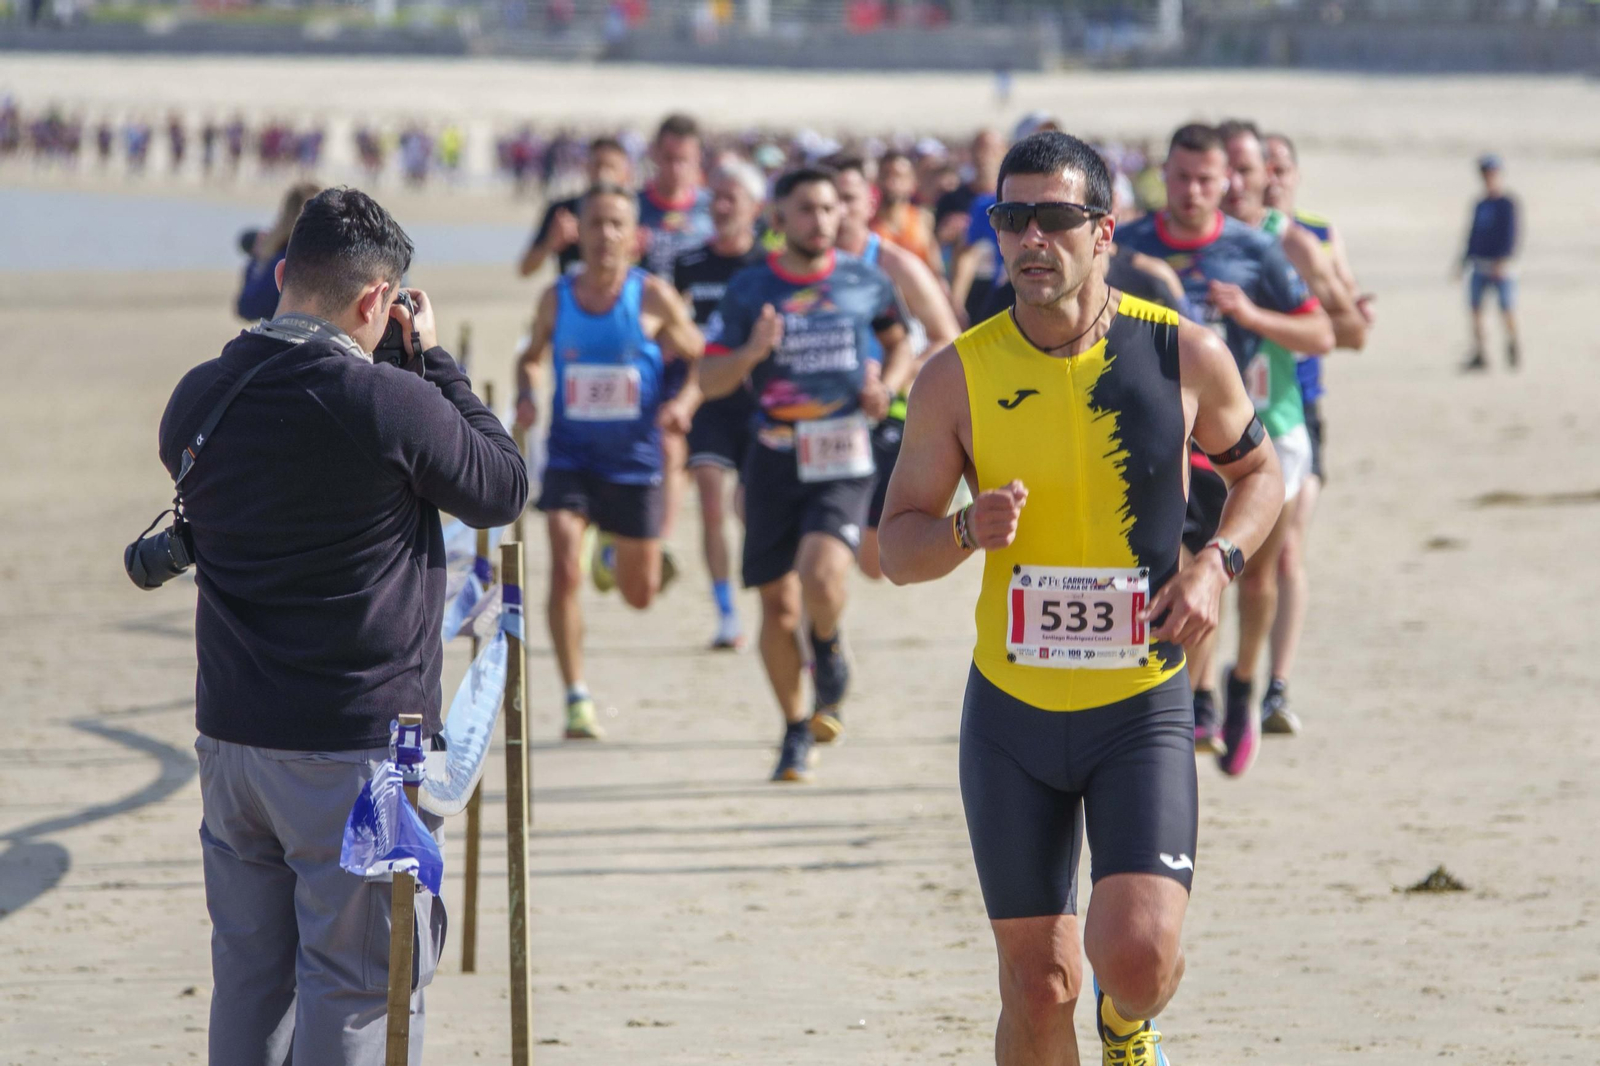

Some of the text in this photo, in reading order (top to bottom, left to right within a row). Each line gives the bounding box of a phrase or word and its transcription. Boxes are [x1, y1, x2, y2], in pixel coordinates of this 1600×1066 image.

[1062, 576, 1098, 585] CARREIRA
[1040, 601, 1114, 632] 533
[1042, 634, 1066, 642] Santiago
